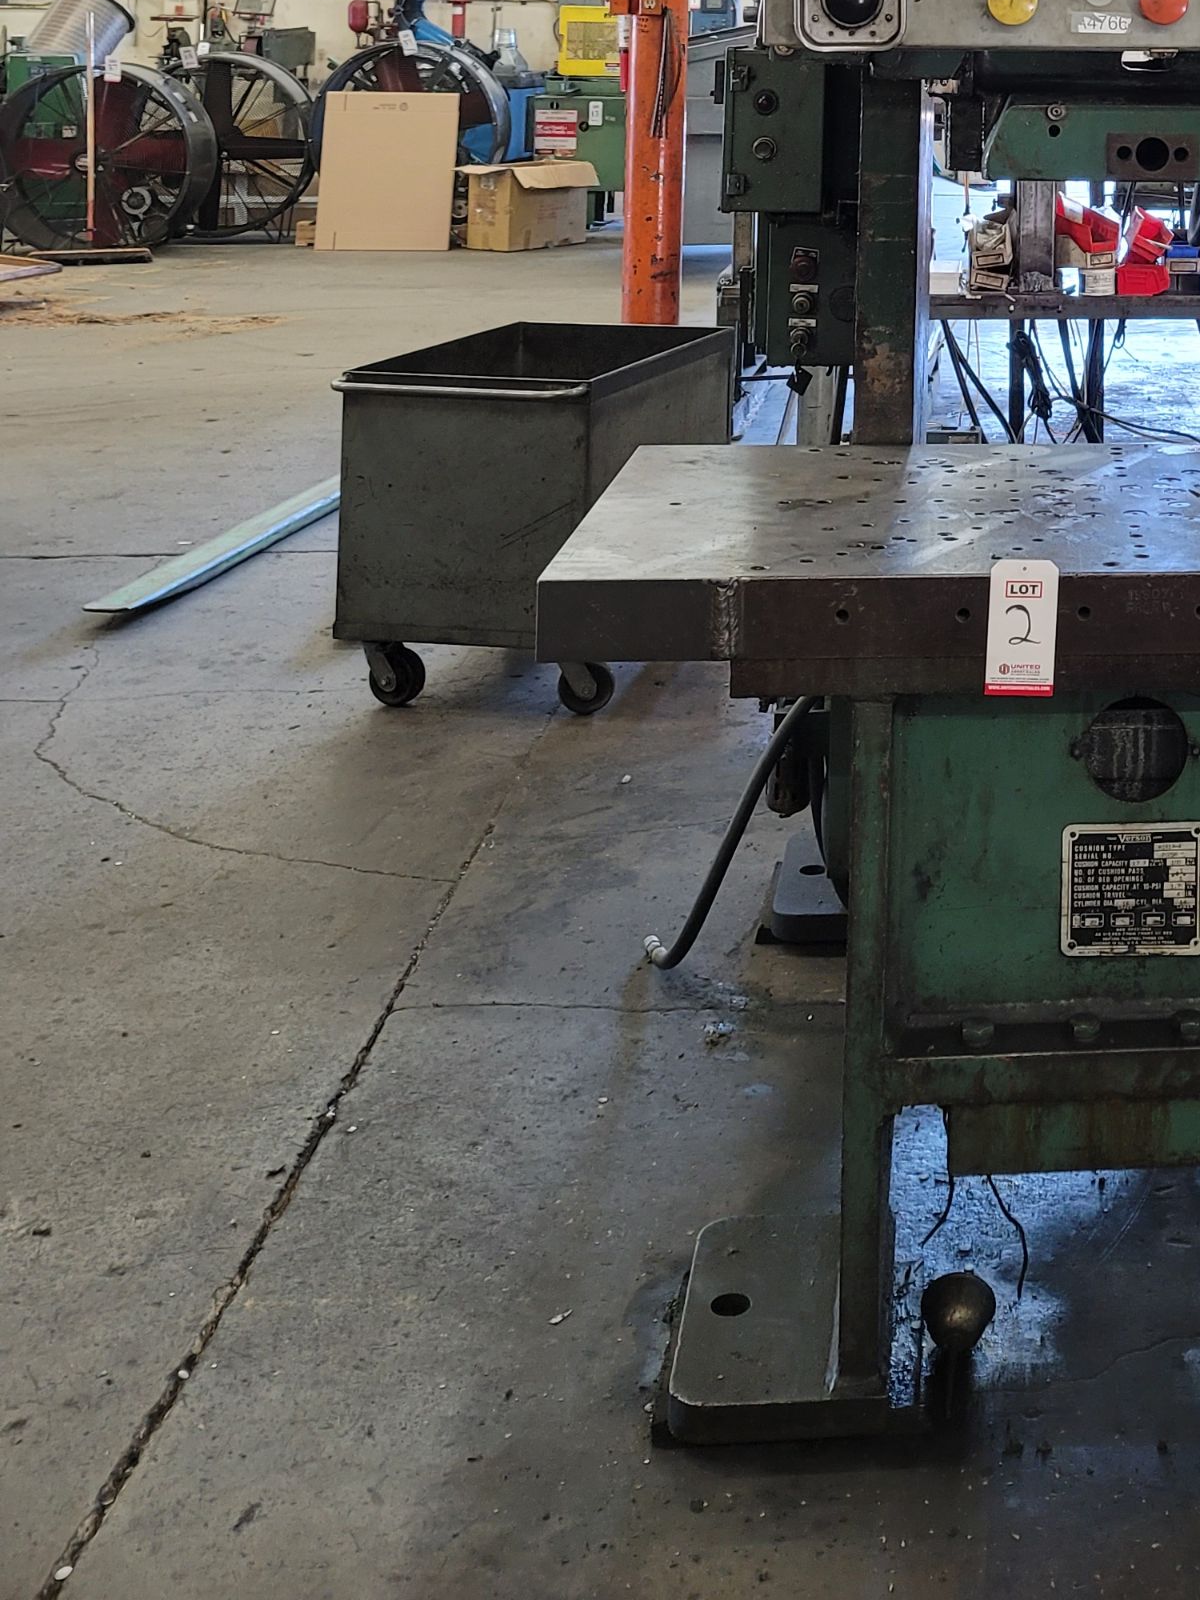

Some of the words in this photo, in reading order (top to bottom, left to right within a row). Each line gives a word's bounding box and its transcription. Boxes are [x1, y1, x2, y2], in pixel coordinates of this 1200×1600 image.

[1010, 584, 1039, 595] LOT
[1005, 604, 1041, 645] 2
[1118, 833, 1151, 844] Verson
[1108, 844, 1126, 852] TYPE
[1074, 852, 1099, 860] SERIAL
[1087, 868, 1095, 876] OF
